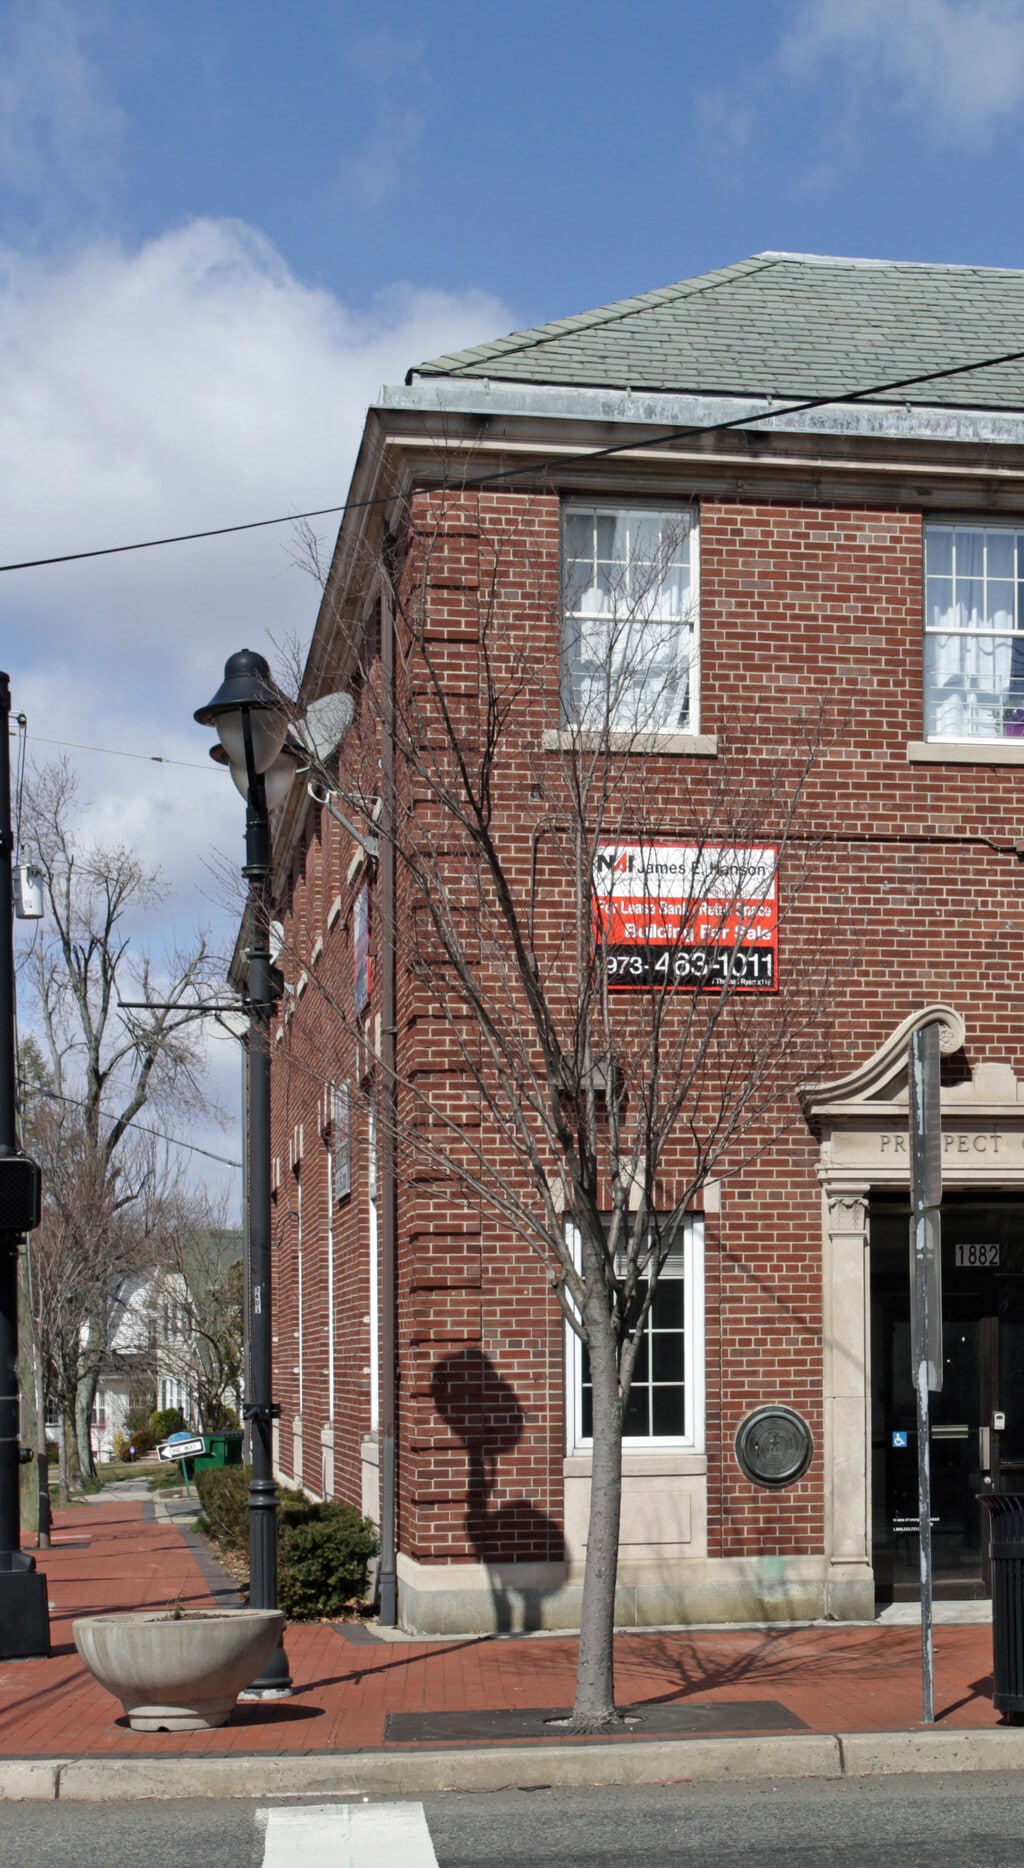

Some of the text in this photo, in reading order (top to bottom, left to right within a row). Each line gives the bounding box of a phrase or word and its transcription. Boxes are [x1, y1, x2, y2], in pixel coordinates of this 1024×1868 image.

[597, 851, 634, 873] NAI
[637, 861, 686, 874] James
[710, 862, 766, 876] Hanson
[621, 901, 656, 915] Lease
[699, 902, 732, 916] Retai
[625, 923, 771, 942] Building For Sale
[880, 1134, 1003, 1153] PRPECT
[958, 1245, 998, 1265] 1882
